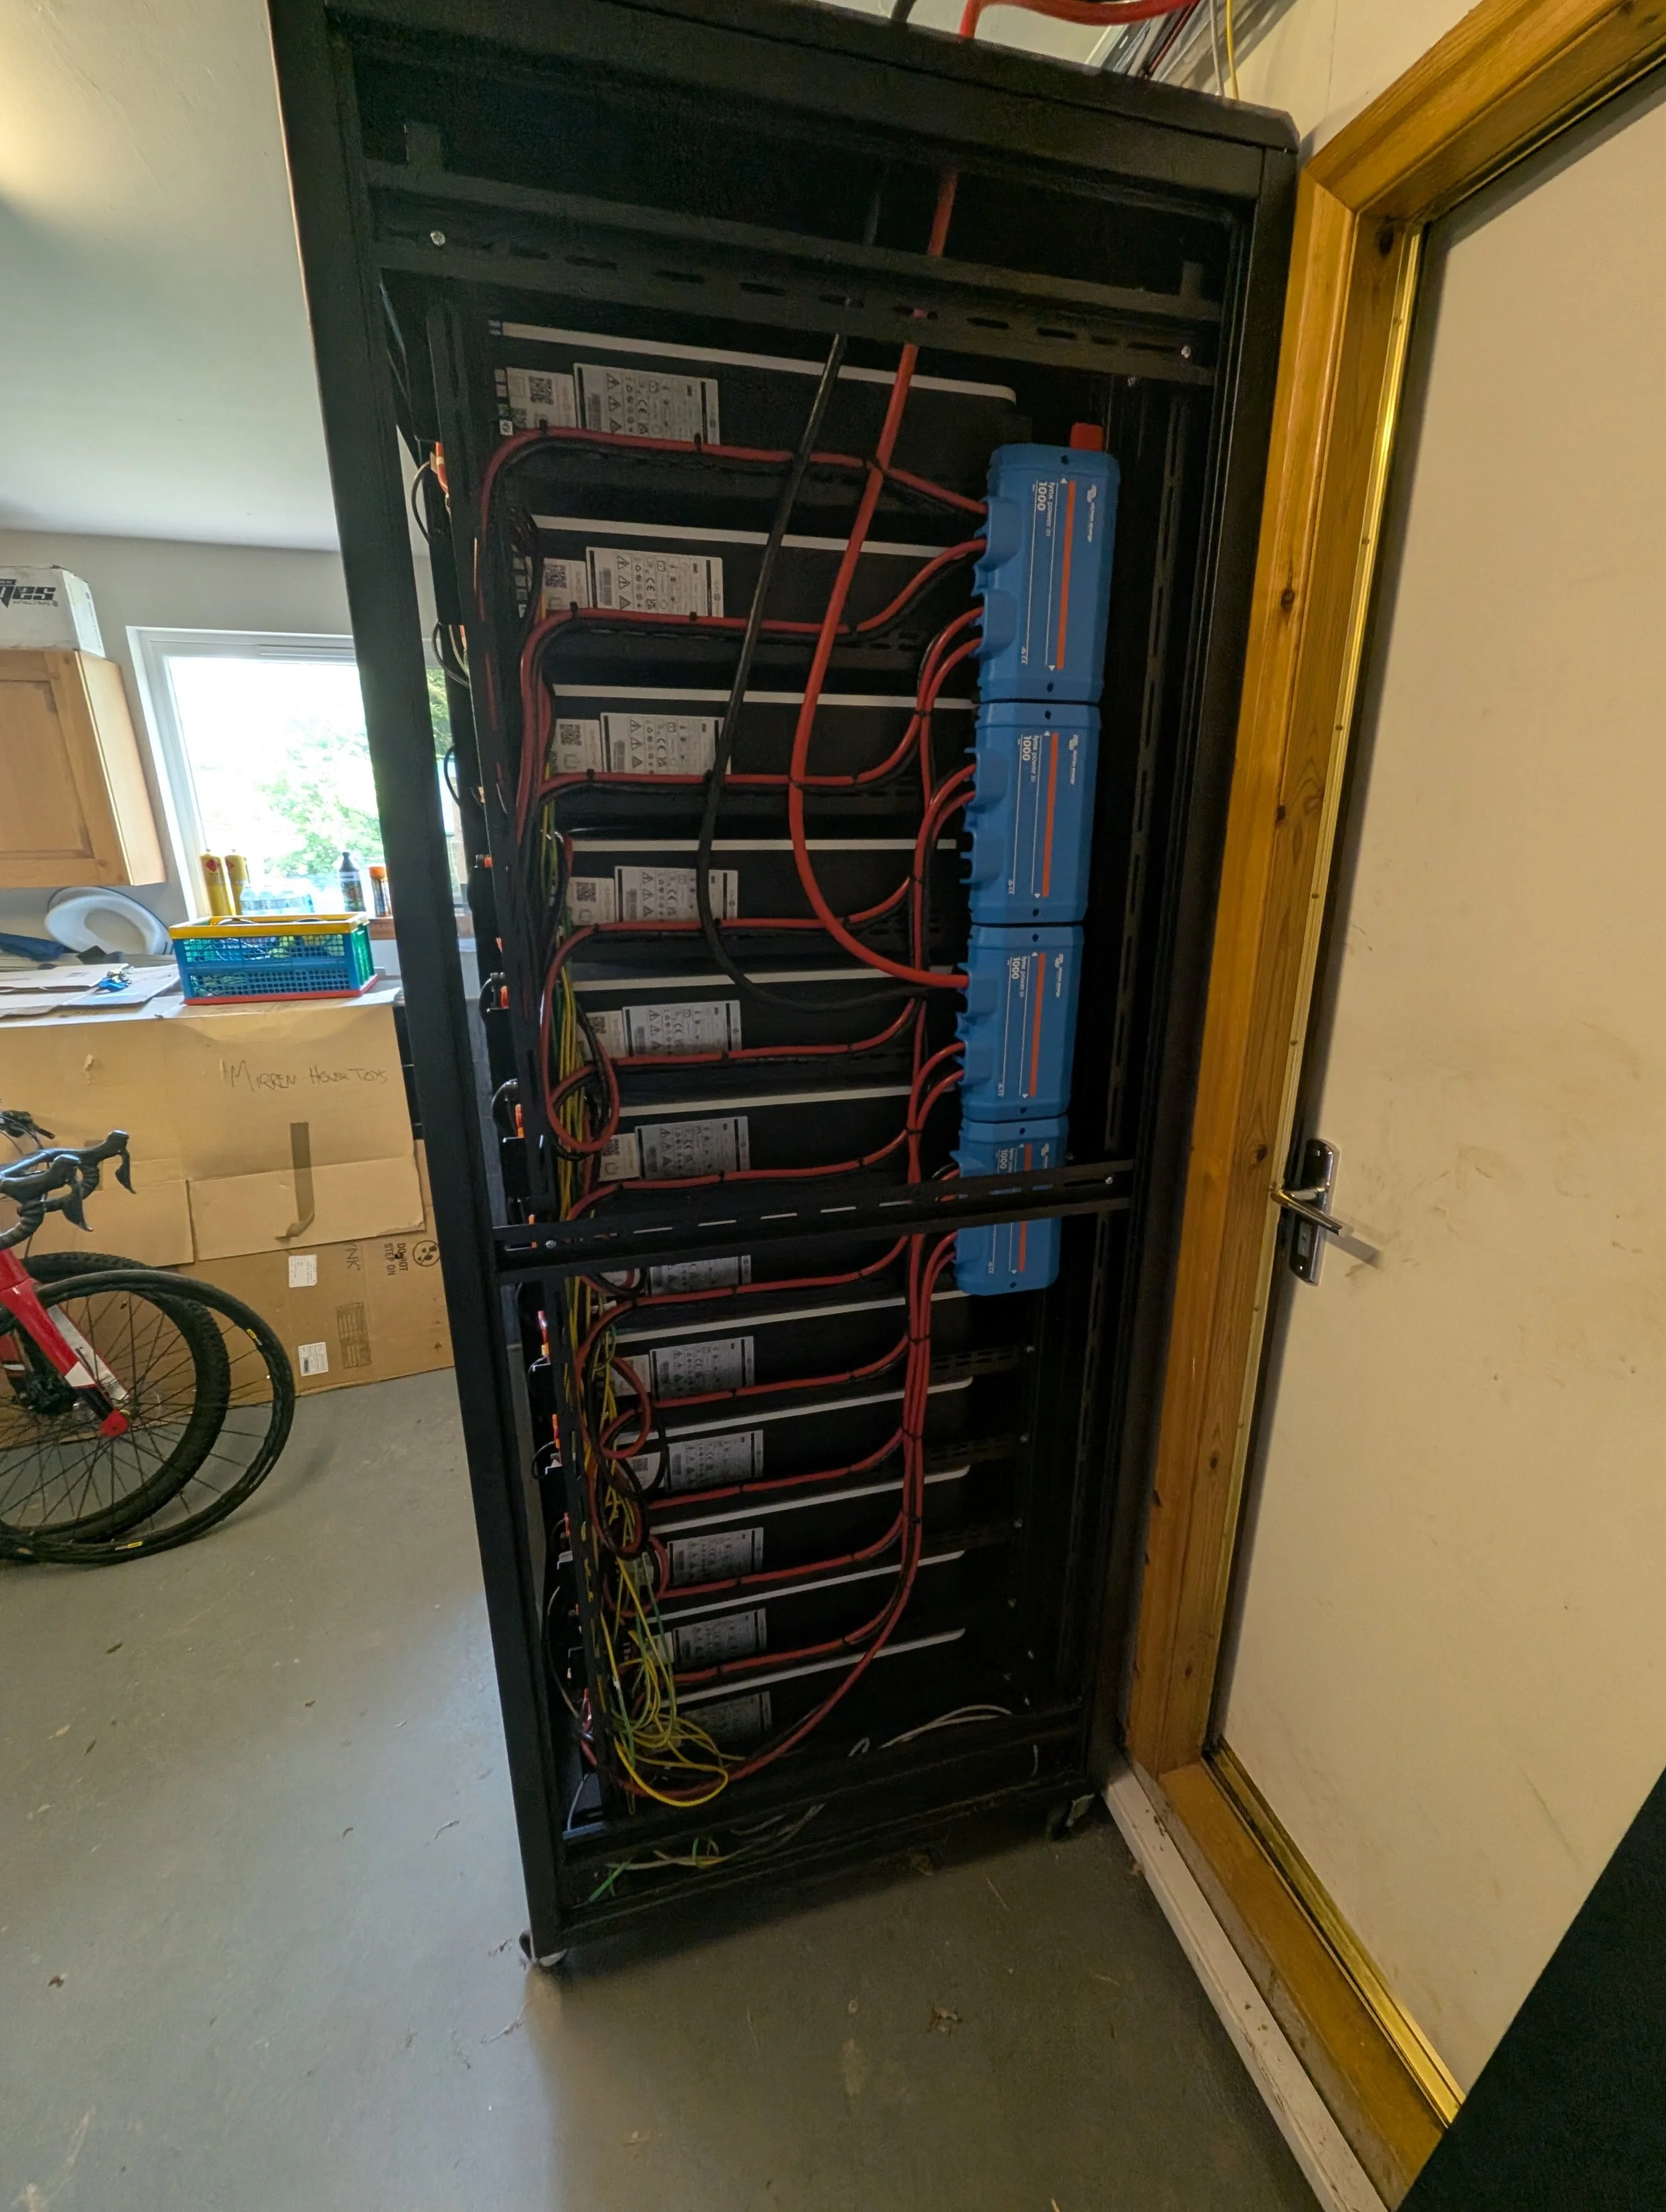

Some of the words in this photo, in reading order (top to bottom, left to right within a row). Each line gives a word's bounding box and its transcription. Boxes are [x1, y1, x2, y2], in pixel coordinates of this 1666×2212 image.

[1037, 482, 1048, 511] 1000
[1022, 735, 1032, 761] 1000
[1012, 957, 1020, 979] 1000
[385, 1243, 395, 1261] STEP
[387, 1264, 396, 1276] ON
